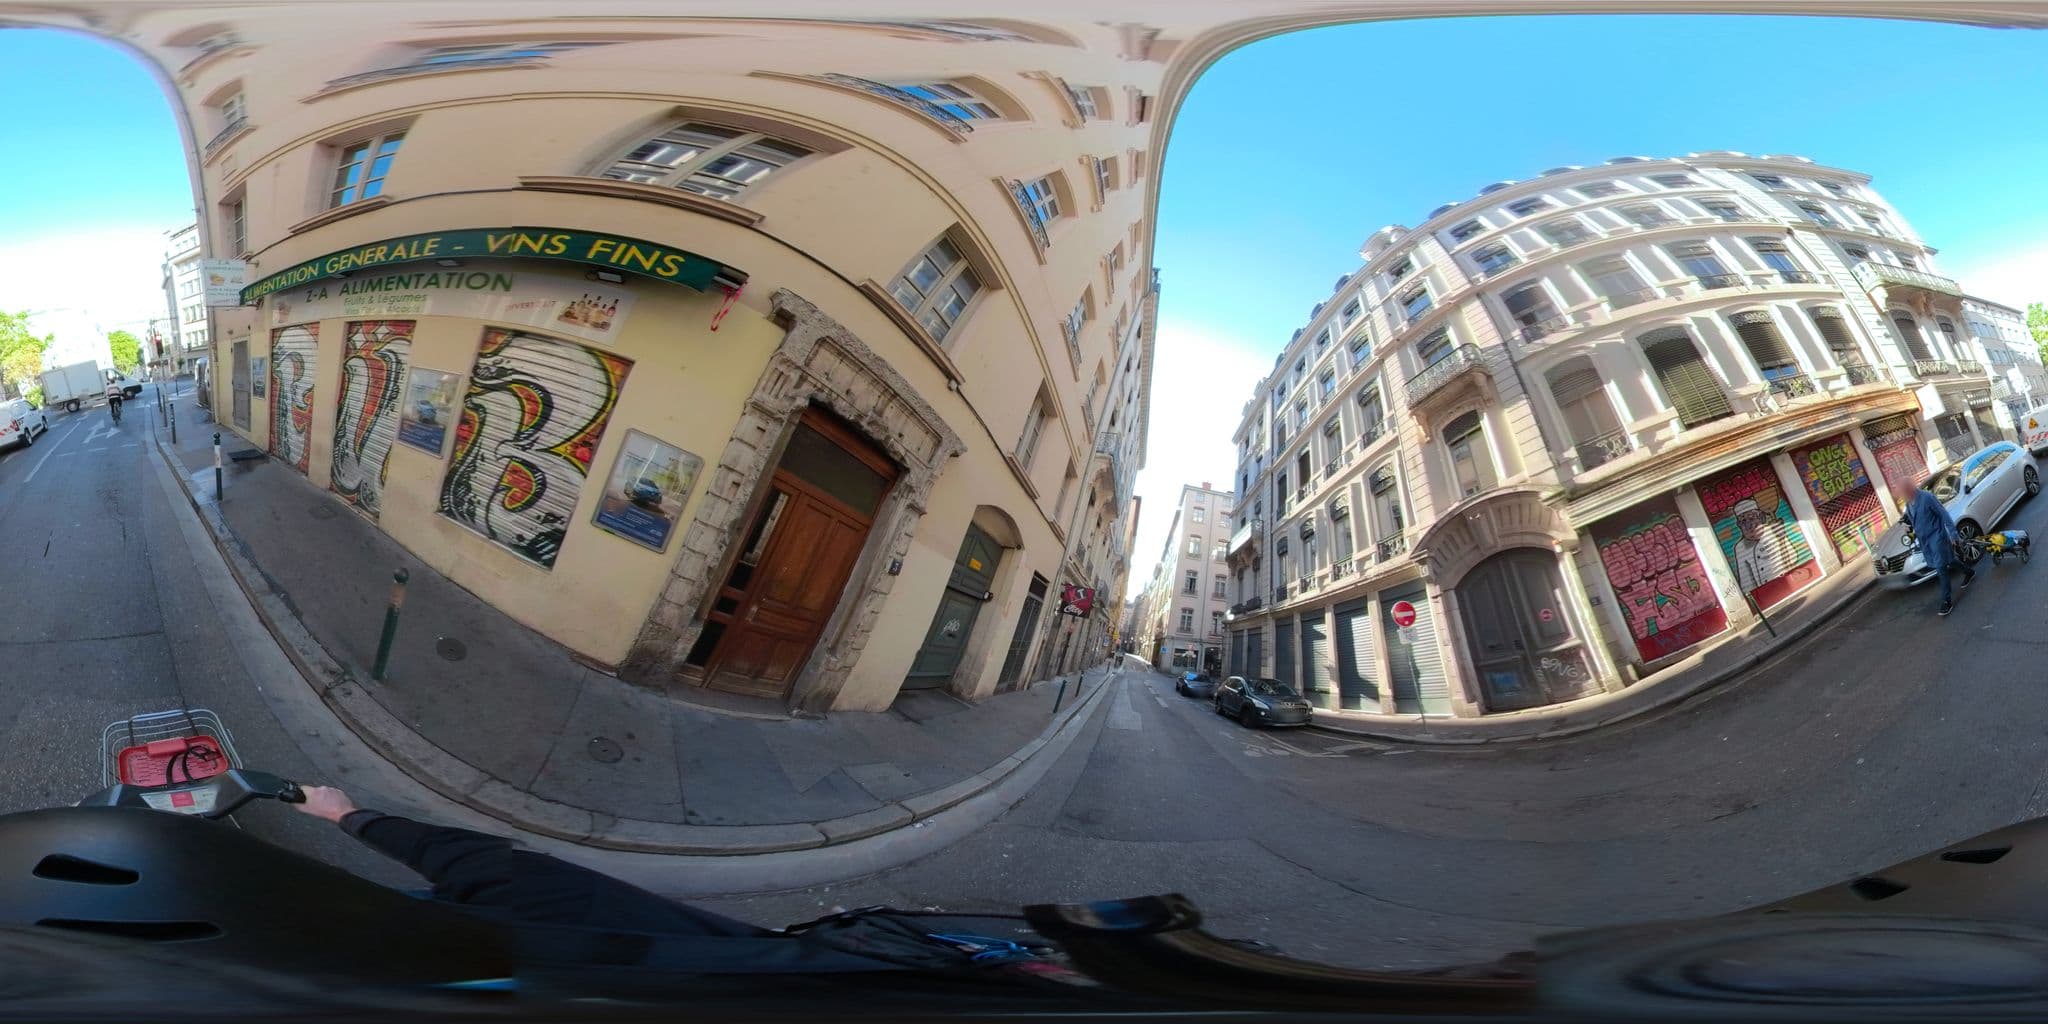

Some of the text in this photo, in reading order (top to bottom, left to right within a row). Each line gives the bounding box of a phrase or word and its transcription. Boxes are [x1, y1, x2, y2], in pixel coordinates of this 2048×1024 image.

[245, 262, 320, 301] ALIMENTATION
[325, 238, 442, 274] GENERALE
[486, 233, 571, 255] VINS
[586, 239, 686, 277] FINS
[339, 271, 513, 297] ALIMENTATION
